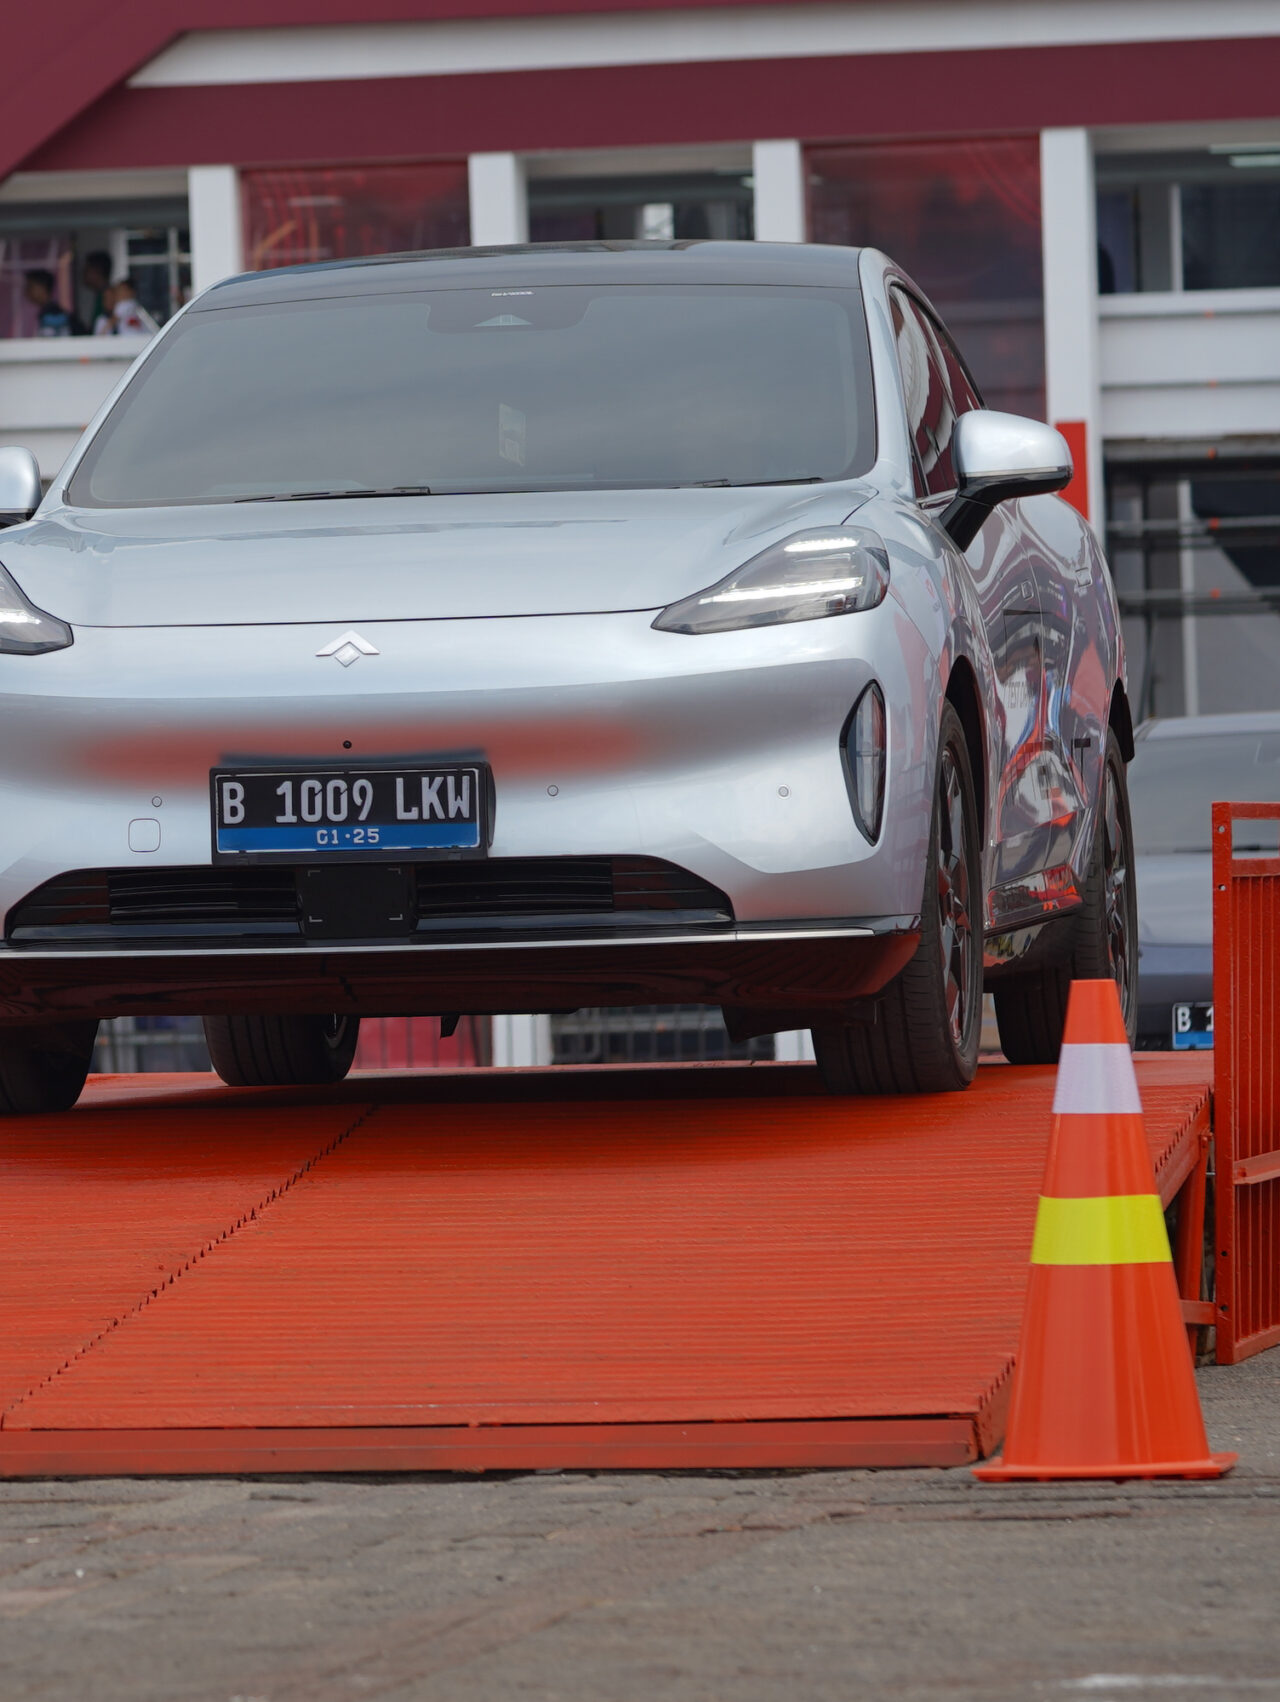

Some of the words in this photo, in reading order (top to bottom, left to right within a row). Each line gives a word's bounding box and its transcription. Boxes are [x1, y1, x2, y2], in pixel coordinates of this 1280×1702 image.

[223, 782, 245, 824] B
[275, 778, 374, 823] 1009
[395, 775, 470, 820] LKW
[1177, 1006, 1191, 1032] B
